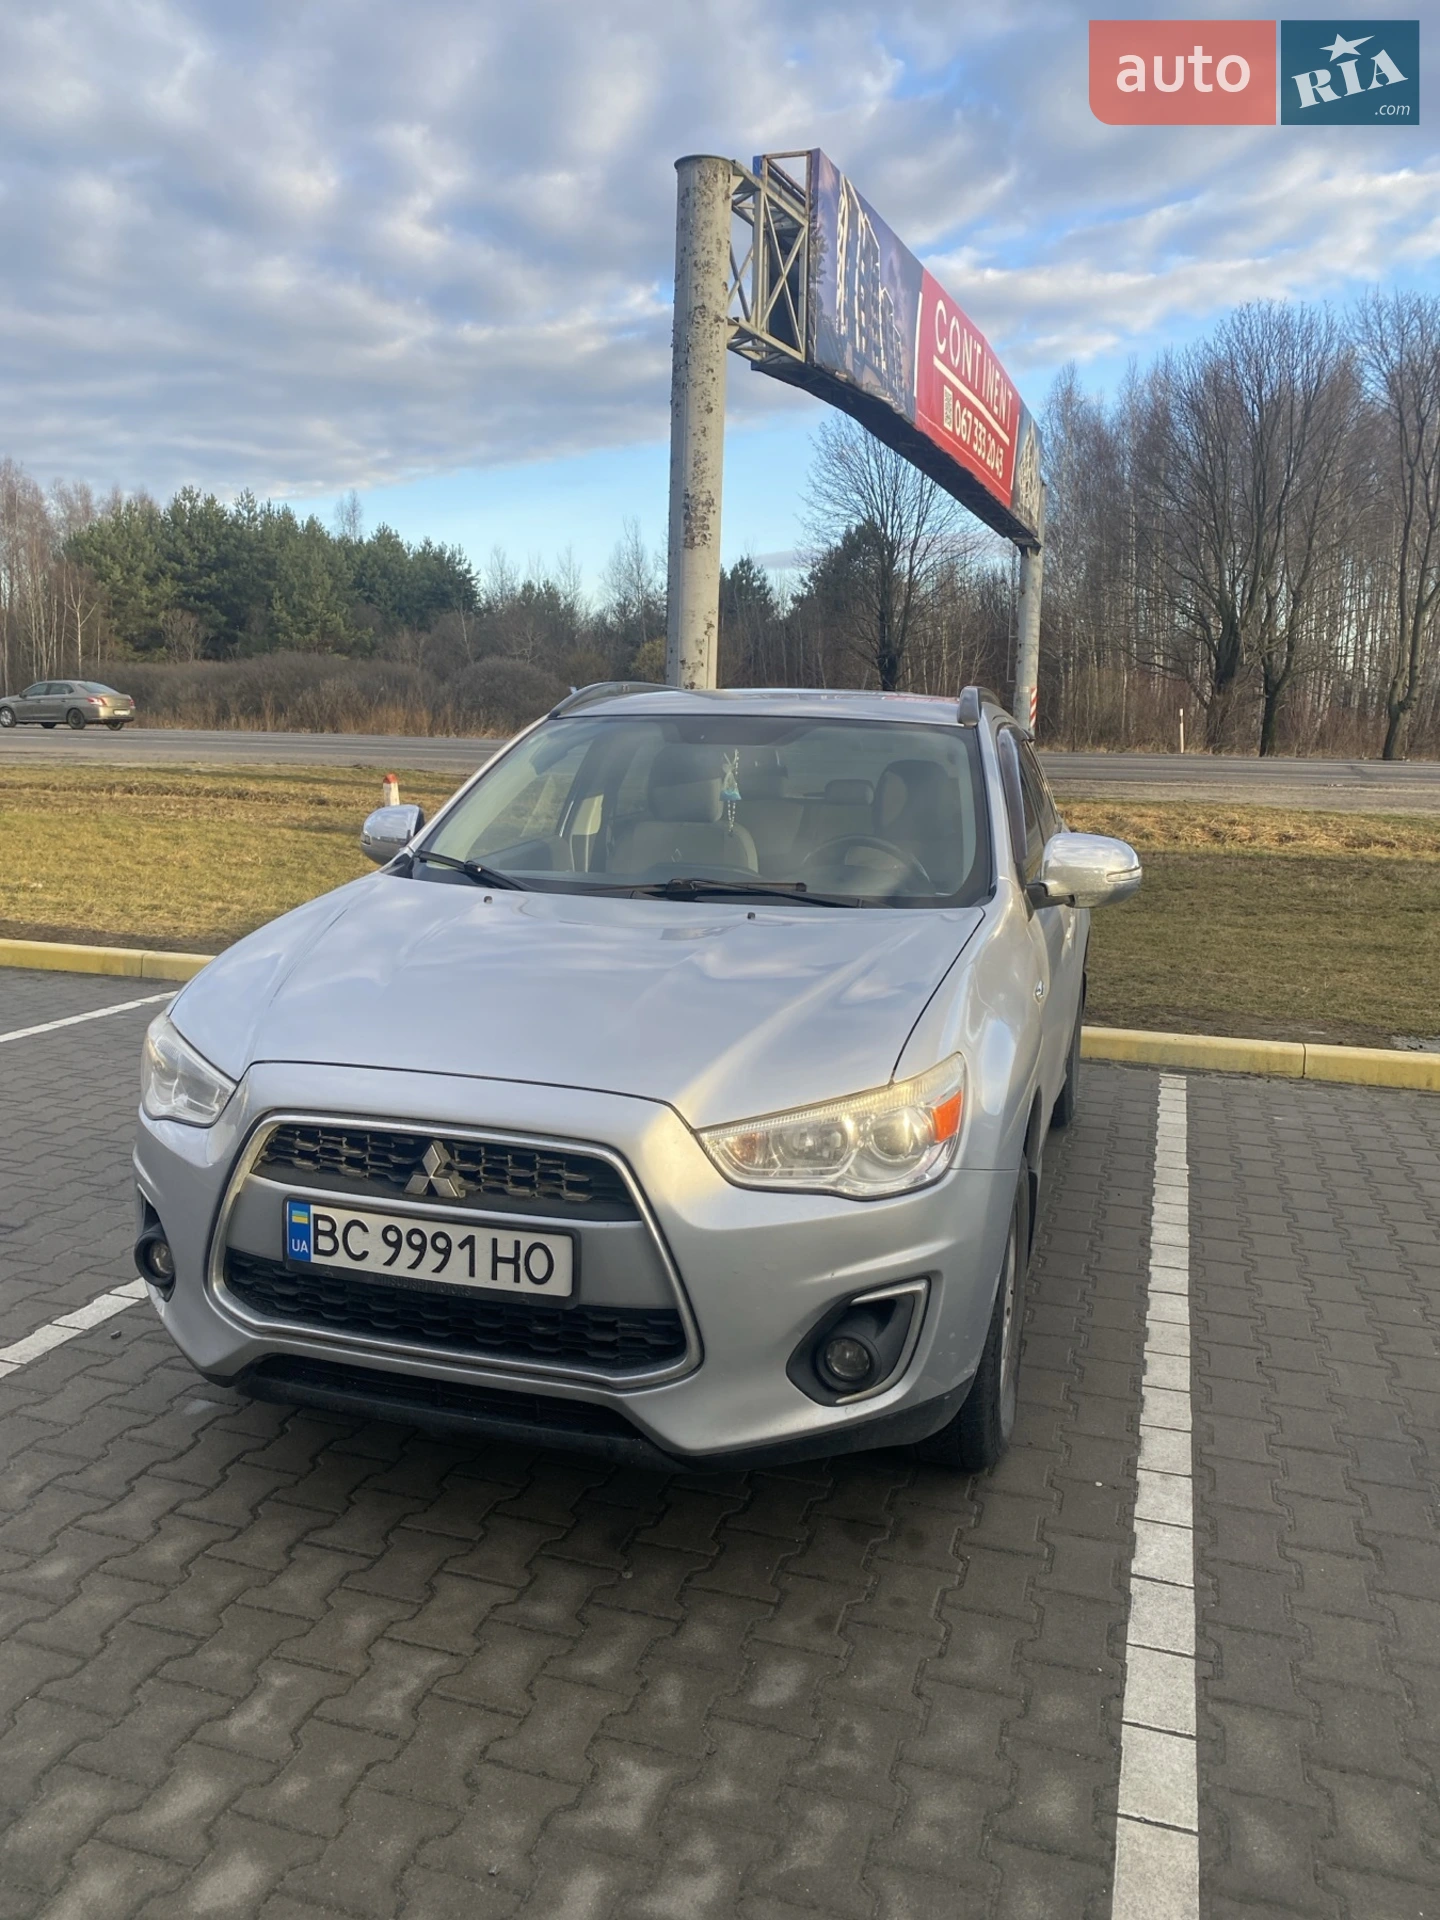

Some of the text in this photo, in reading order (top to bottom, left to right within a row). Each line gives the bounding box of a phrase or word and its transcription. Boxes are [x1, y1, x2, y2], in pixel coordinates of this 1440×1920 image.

[935, 299, 1013, 430] CONTINENT
[954, 399, 973, 445] 067
[291, 1239, 308, 1254] UA
[313, 1213, 555, 1285] BC 9991 HO
